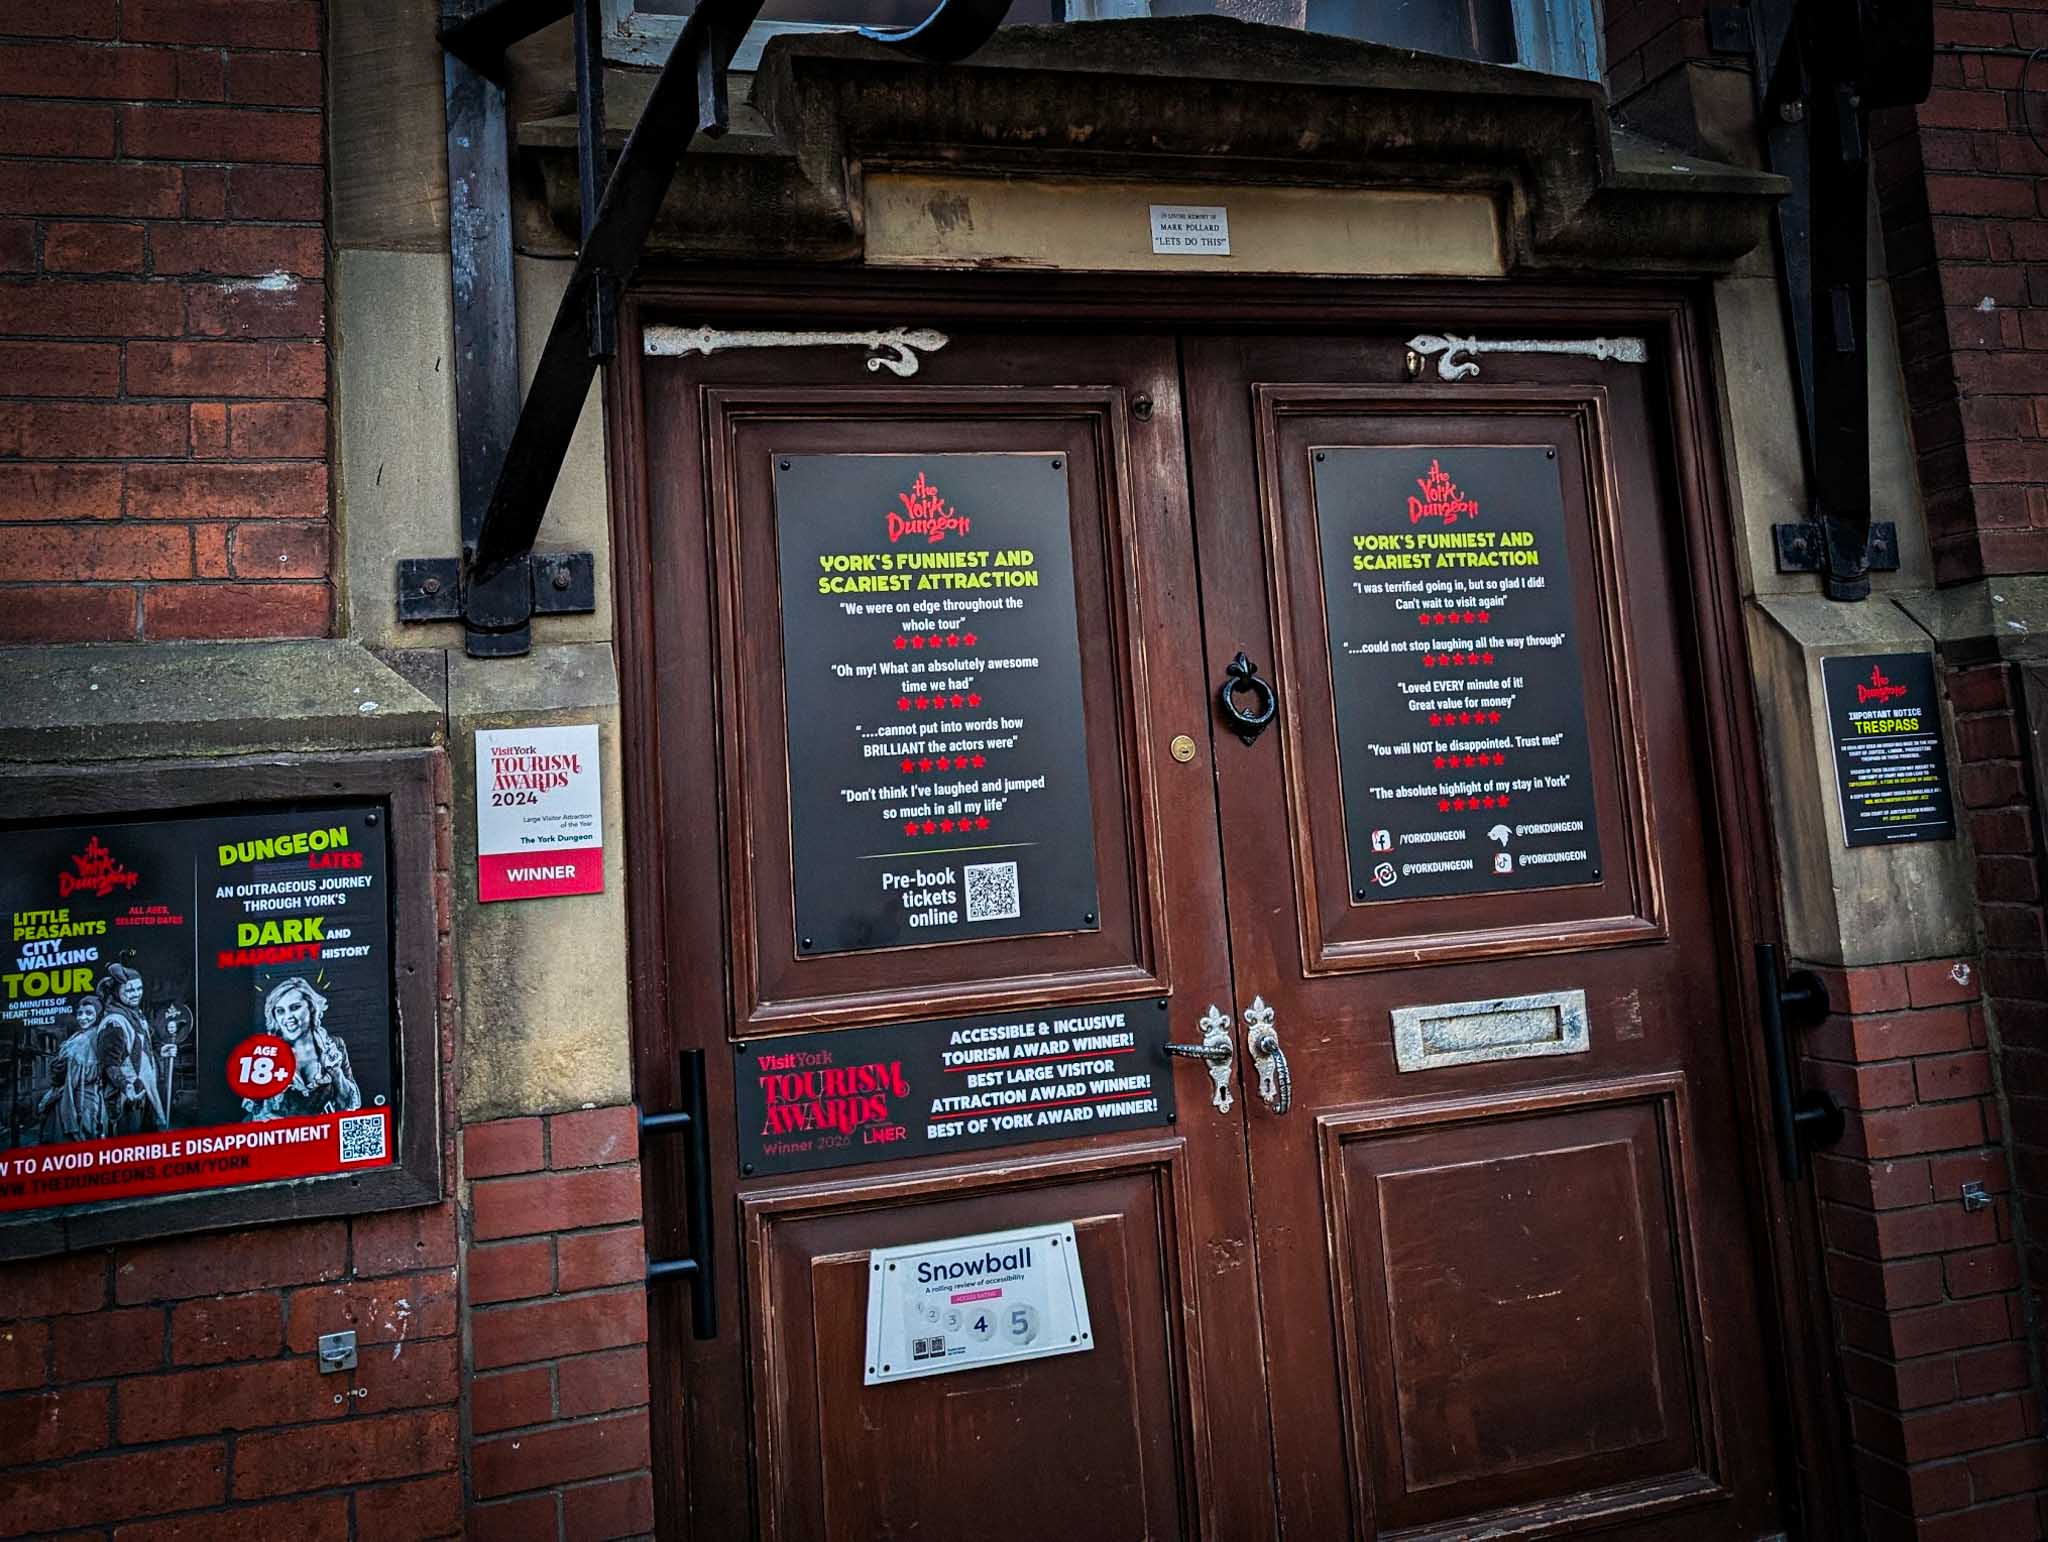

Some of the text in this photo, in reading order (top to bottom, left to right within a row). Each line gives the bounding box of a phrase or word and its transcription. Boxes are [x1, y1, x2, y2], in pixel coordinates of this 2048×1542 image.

[1184, 238, 1197, 246] DO
[1416, 477, 1465, 502] York
[899, 493, 955, 520] York
[1407, 495, 1479, 525] Dungeon
[886, 512, 971, 544] Dungeon
[1353, 531, 1534, 550] YORK'S FUNNIEST AND
[819, 549, 1034, 573] YORK'S FUNNIEST AND
[1353, 550, 1539, 571] SCARIEST ATTRACTION
[817, 570, 1039, 594] SCARIEST ATTRACTION
[865, 602, 893, 614] were
[896, 601, 911, 613] on
[912, 599, 940, 614] edge
[943, 598, 1004, 614] throughout
[1005, 596, 1024, 609] the
[1395, 598, 1420, 610] Can't
[1422, 597, 1445, 609] wait
[1447, 597, 1455, 608] to
[1456, 596, 1476, 607] visit
[902, 618, 936, 631] whole
[856, 663, 877, 678] my!
[879, 662, 909, 675] What
[911, 663, 925, 673] an
[927, 659, 985, 673] absolutely
[988, 658, 1039, 669] awesome
[1433, 680, 1464, 693] EVERY
[1467, 678, 1500, 690] minute
[1501, 677, 1512, 688] of
[1513, 676, 1523, 688] it!
[1848, 708, 1922, 721] IMPORTANT NOTICE
[1855, 718, 1919, 734] TRESPASS
[491, 753, 582, 775] TOURISM
[493, 772, 568, 793] AWARDS
[878, 785, 908, 800] think
[911, 784, 931, 798] I've
[933, 780, 979, 797] laughed
[981, 778, 1002, 792] and
[1003, 776, 1045, 794] jumped
[1396, 783, 1438, 798] absolute
[1439, 781, 1482, 797] highlight
[1483, 780, 1494, 791] of
[1495, 780, 1511, 793] my
[1512, 778, 1533, 791] stay
[1534, 777, 1543, 788] in
[492, 792, 538, 807] 2024
[523, 816, 541, 824] Large
[1515, 821, 1584, 837] @YORKDUNGEON
[218, 826, 349, 866] DUNGEON
[537, 835, 556, 843] York
[558, 833, 593, 843] Dungeon
[309, 852, 363, 869] LATES
[1402, 859, 1473, 876] @YORKDUNGEON
[1518, 850, 1587, 866] @YORKDUNGEON
[507, 865, 575, 881] WINNER
[882, 867, 956, 890] Pre-book
[58, 871, 139, 897] Dungeon
[216, 875, 373, 898] AN OUTRAGEOUS JOURNEY
[243, 893, 346, 912] THROUGH YORK'S
[902, 888, 957, 908] tickets
[13, 908, 70, 926] LITTLE
[909, 907, 958, 928] online
[13, 921, 107, 941] PEASANTS
[238, 917, 351, 947] DARK AND
[22, 939, 63, 957] CITY
[217, 943, 371, 969] NAUGHTY HISTORY
[17, 947, 99, 971] WALKING
[2, 967, 95, 999] TOUR
[2, 1006, 73, 1020] HEART-THUMPING
[9, 997, 67, 1010] 60 MINUTES OF
[23, 1018, 55, 1026] THRILLS
[950, 1013, 1126, 1045] ACCESSIBLE & INCLUSIVE
[253, 1045, 278, 1057] AGE
[942, 1032, 1134, 1067] TOURISM AWARD WINNER!
[239, 1056, 289, 1085] 18+
[967, 1059, 1115, 1089] BEST LARGE VISITOR
[759, 1060, 910, 1104] TOURISM
[931, 1075, 1151, 1113] ATTRACTION AWARD WINNER!
[760, 1093, 889, 1135] AWARDS
[927, 1098, 1158, 1139] BEST OF YORK AWARD WINNER!
[863, 1126, 908, 1145] LNER
[13, 1159, 37, 1176] TO
[41, 1151, 94, 1172] AVOID
[99, 1140, 181, 1166] HORRIBLE
[185, 1124, 331, 1156] DISAPPOINTMENT
[763, 1141, 813, 1155] Winner
[917, 1247, 1032, 1284] Snowball
[932, 1283, 953, 1293] rolling
[954, 1281, 976, 1290] review
[977, 1279, 984, 1287] of
[985, 1273, 1025, 1286] accessibility
[974, 1315, 988, 1333] 4
[1011, 1310, 1028, 1335] 5
